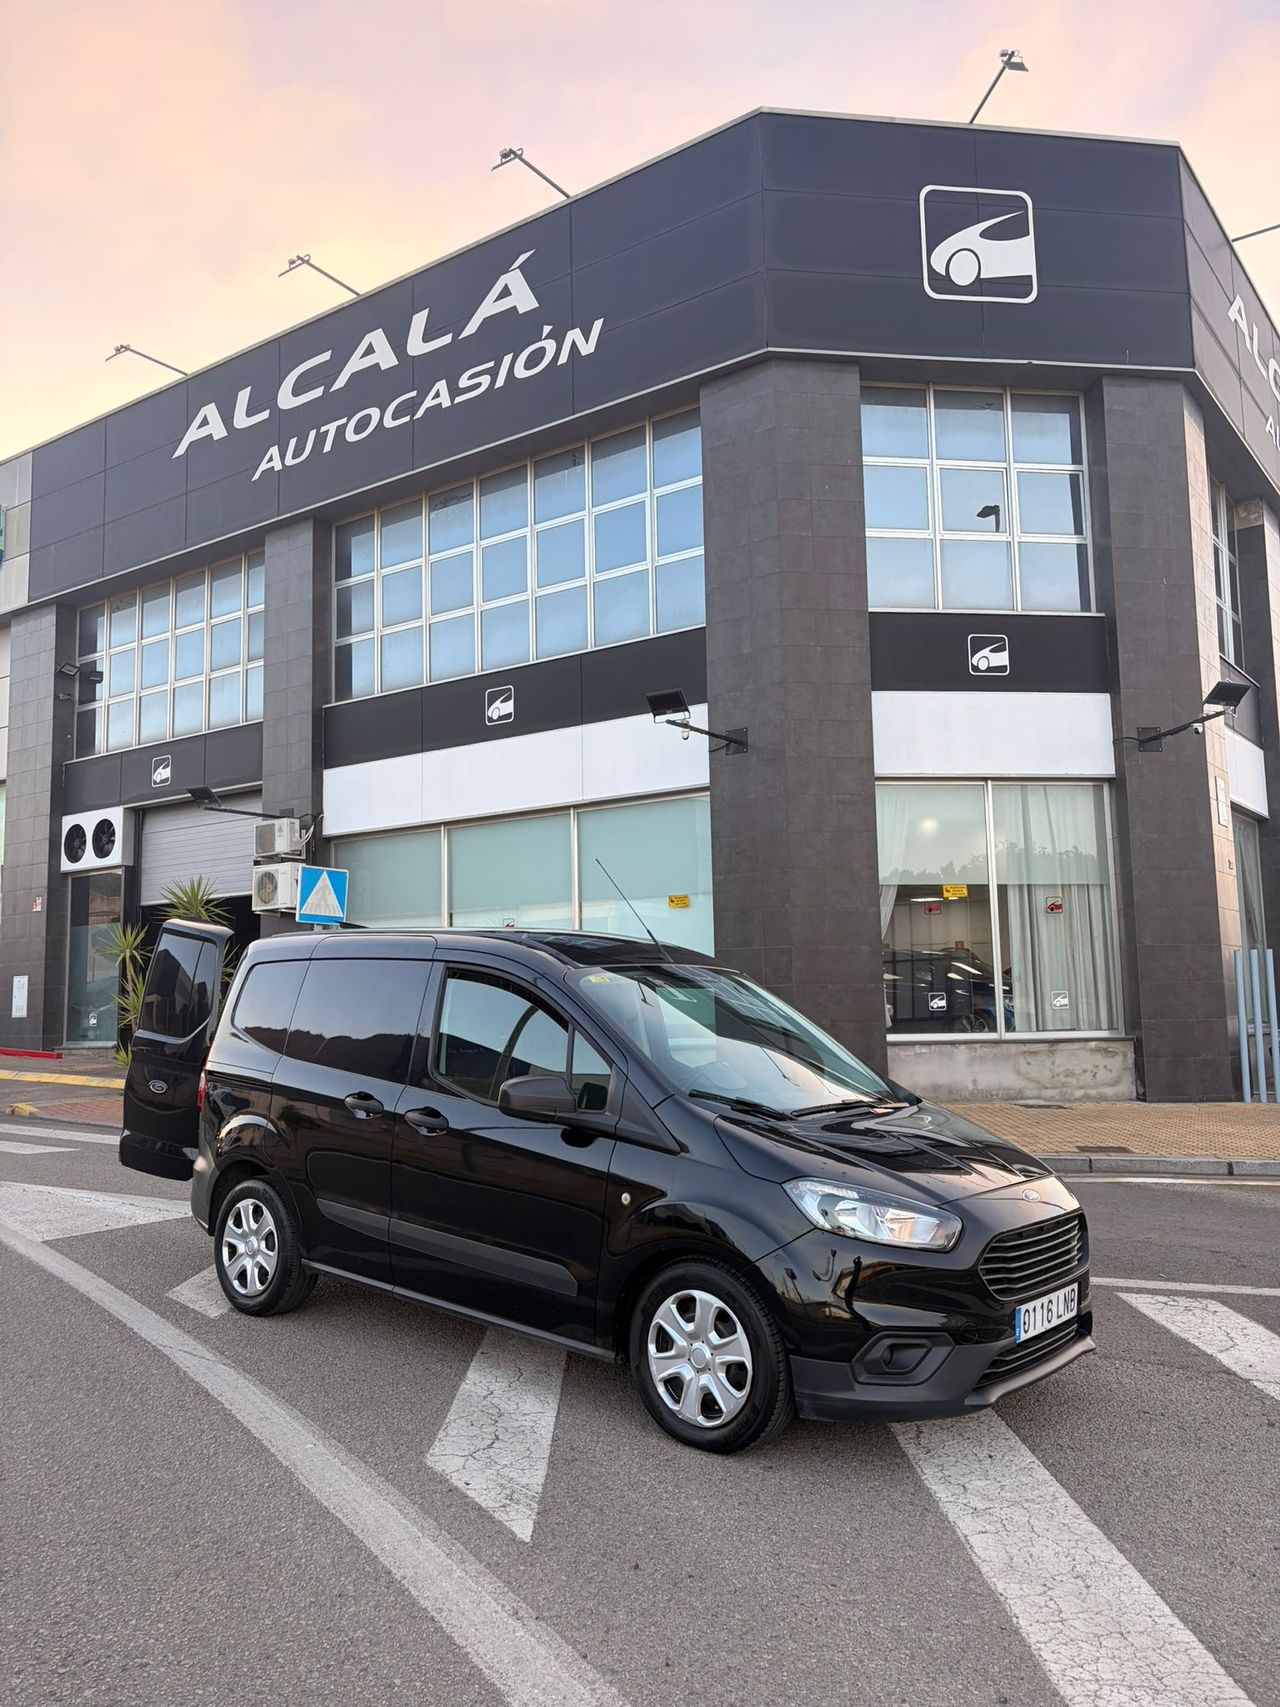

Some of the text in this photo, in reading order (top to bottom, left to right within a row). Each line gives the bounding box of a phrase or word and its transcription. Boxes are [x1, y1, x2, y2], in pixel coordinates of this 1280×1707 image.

[171, 249, 540, 459] ALCALÁ
[251, 317, 604, 482] AUTOCASIÓN
[1023, 1288, 1076, 1334] 0116 LNB
